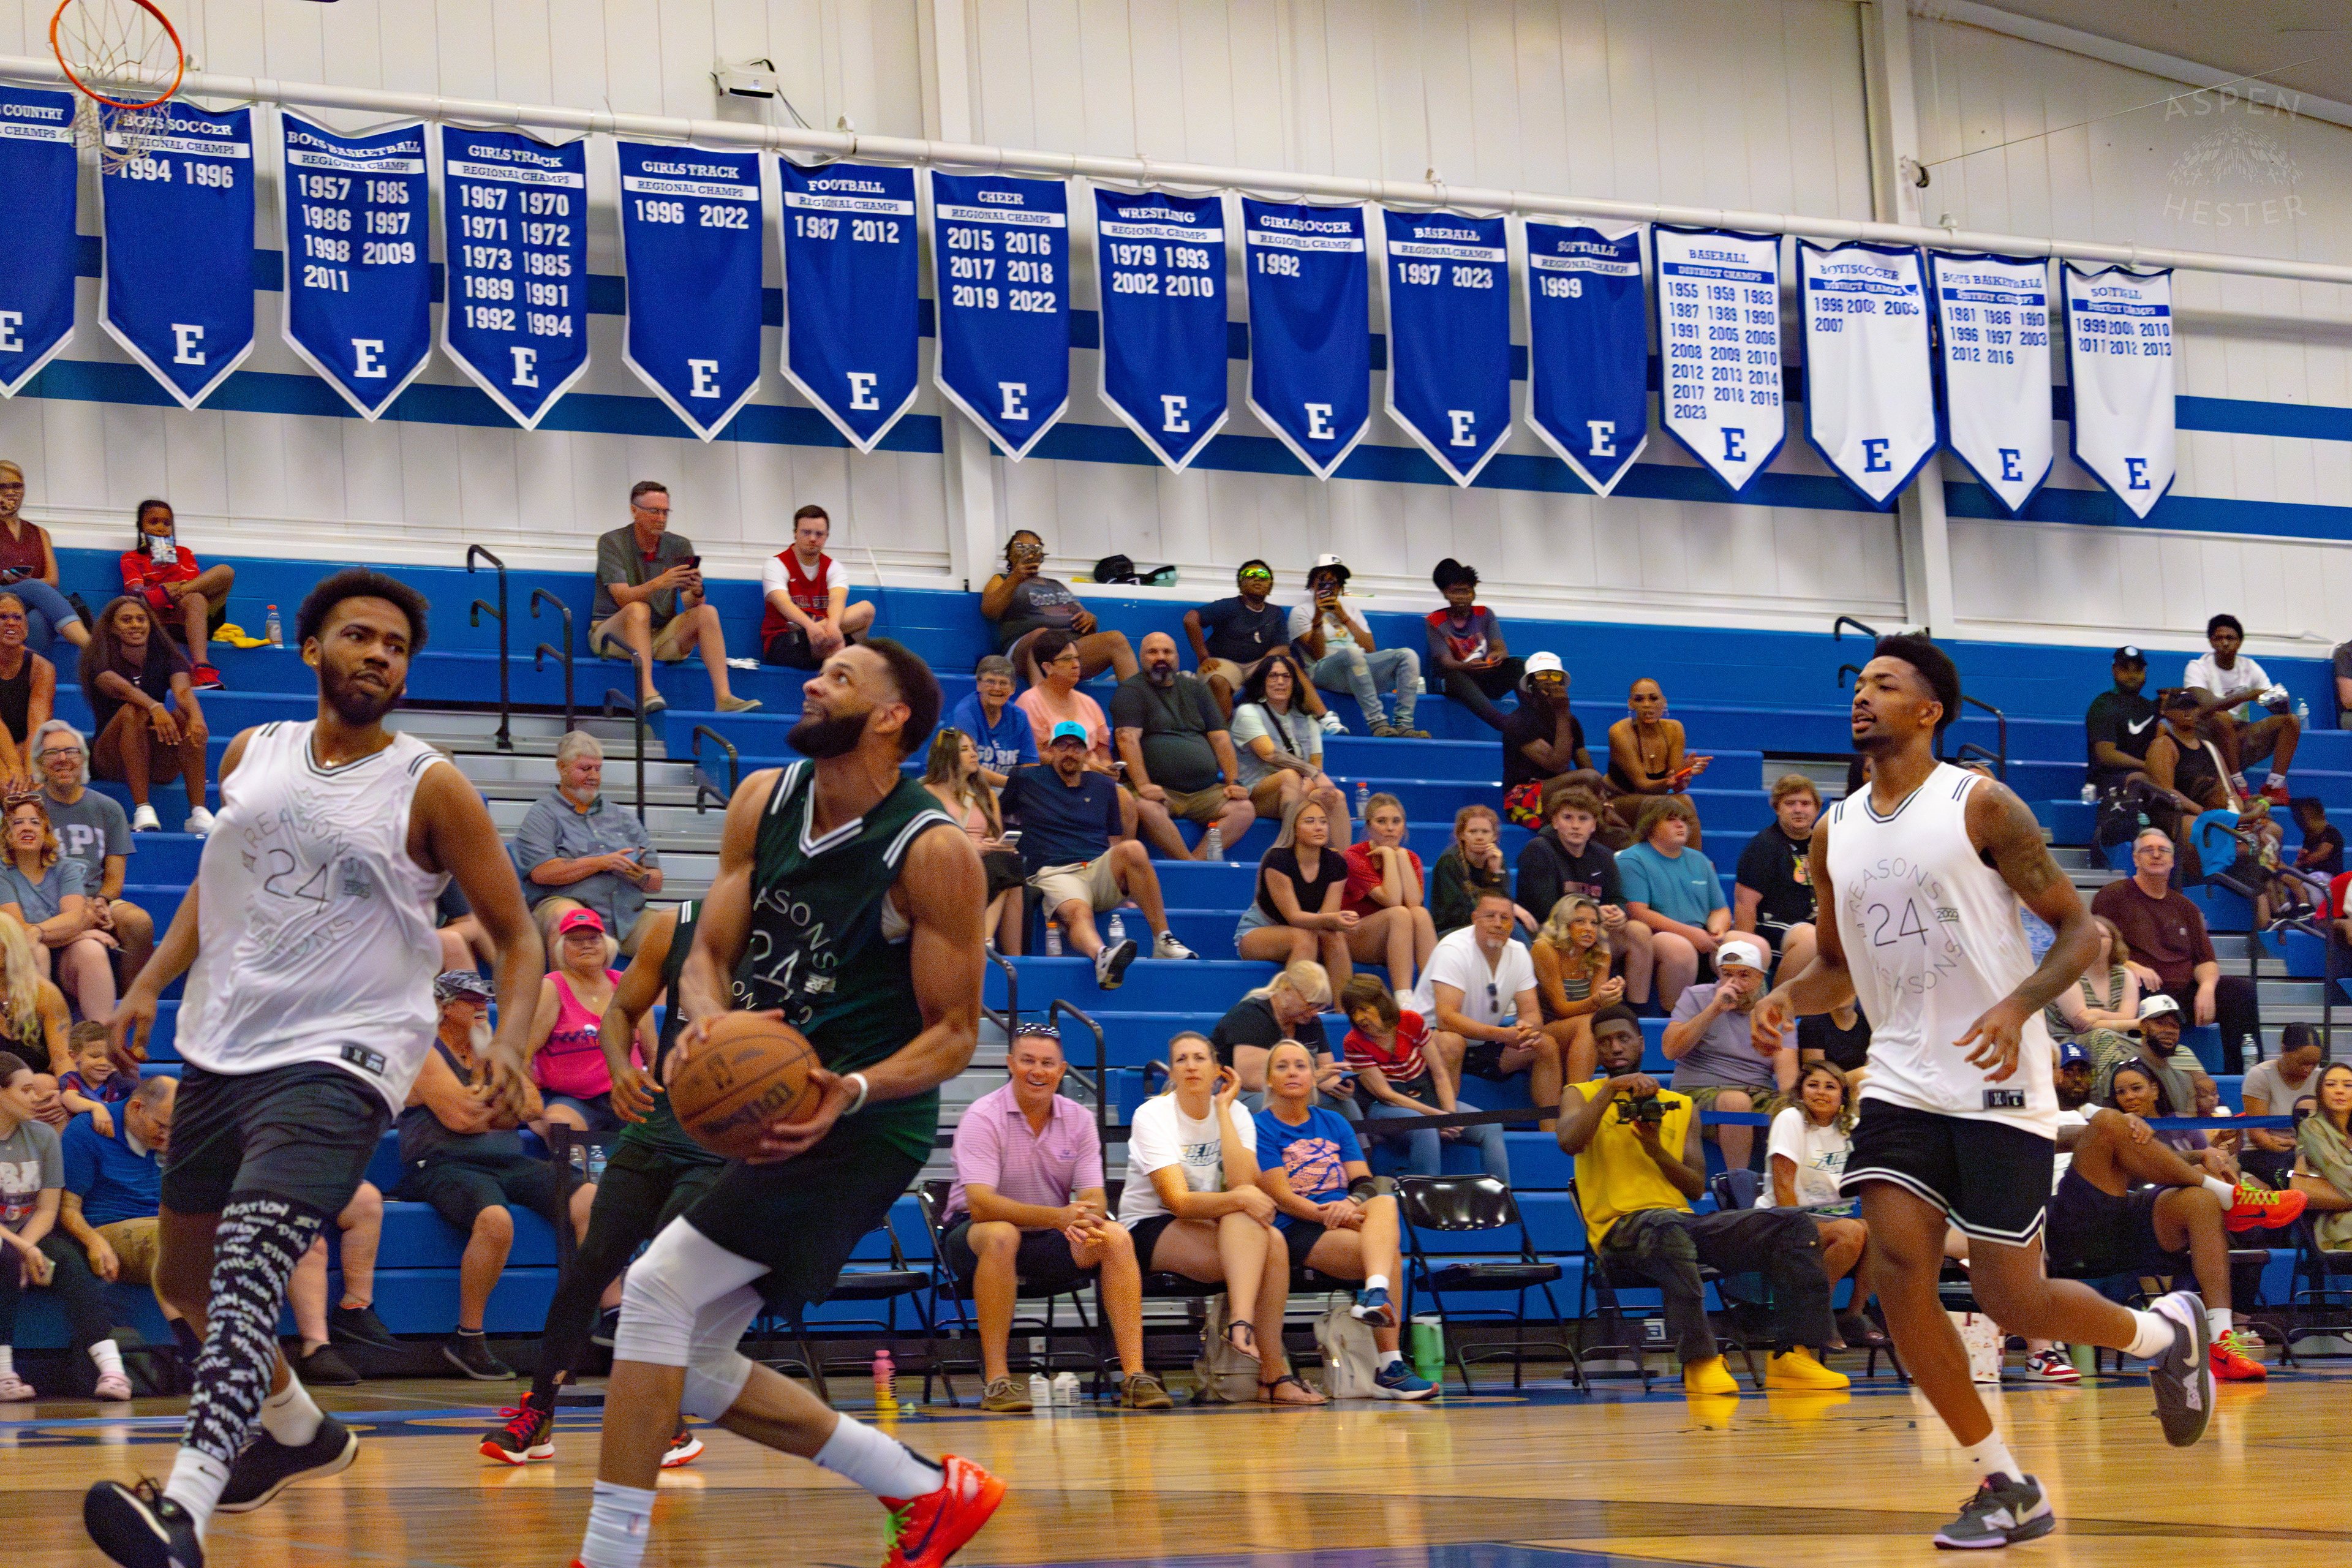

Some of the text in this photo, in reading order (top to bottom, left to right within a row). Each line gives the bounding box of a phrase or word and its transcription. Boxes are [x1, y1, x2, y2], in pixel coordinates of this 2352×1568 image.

[5, 126, 56, 138] CHAMPS
[123, 115, 233, 135] BOYS SOCCER
[187, 142, 234, 154] CHAMPS
[287, 132, 421, 158] BOYS BASKETBALL
[468, 145, 563, 167] GIRLS TRACK
[119, 159, 233, 187] 1994 1996
[302, 155, 365, 170] REGIONAL
[463, 165, 569, 184] REGIONAL CHAMPS
[641, 161, 739, 179] GIRLS TRACK
[298, 174, 409, 204] 1957 1985
[638, 181, 744, 197] REGIONAL CHAMPS
[807, 179, 885, 193] FOOTBALL
[978, 191, 1024, 205] CHEER
[461, 185, 569, 216] 1967 1970
[854, 201, 899, 211] CHAMPS
[302, 205, 410, 234] 1986 1997
[635, 200, 748, 229] 1996 2022
[952, 209, 1050, 224] REGIONAL CHAMPS
[1118, 208, 1196, 222] WRESTLING
[461, 215, 570, 246] 1971 1972
[795, 216, 899, 243] 1987 2012
[948, 227, 1050, 255] 2015 2016
[1413, 227, 1480, 241] BASEBALL
[304, 235, 415, 264] 1998 2009
[463, 245, 571, 276] 1973 1985
[1110, 244, 1210, 270] 1979 1993
[1689, 249, 1749, 263] BASEBALL
[951, 256, 1053, 284] 2017 2018
[1256, 253, 1300, 277] 1992
[1398, 263, 1493, 288] 1997 2023
[304, 265, 349, 292] 2011
[464, 276, 568, 307] 1989 1991
[1113, 271, 1213, 297] 2002 2010
[1540, 276, 1582, 298] 1999
[952, 285, 1057, 312] 2019 2022
[1668, 282, 1773, 305] 1955 1959 1983
[465, 306, 572, 337] 1992 1994
[1670, 302, 1698, 318] 1987
[1744, 309, 1774, 325] 1990
[1815, 317, 1843, 332] 2007
[1948, 307, 1975, 322] 1981
[1671, 323, 1776, 345] 1991 2005 2006
[2077, 318, 2106, 333] 1999
[2139, 323, 2169, 337] 2010
[172, 323, 205, 365] E
[1671, 343, 1702, 359] 2008
[1747, 350, 1777, 366] 2010
[1952, 346, 2013, 364] 2012 2016
[2079, 338, 2171, 356] 2011 2012 2013
[352, 339, 386, 377] E
[511, 347, 538, 388] E
[688, 359, 720, 398] E
[1672, 364, 1703, 380] 2012
[1749, 370, 1778, 385] 2014
[847, 372, 879, 410] E
[998, 382, 1028, 420] E
[1673, 384, 1704, 399] 2017
[1750, 390, 1779, 406] 2019
[1161, 395, 1189, 432] E
[1305, 403, 1334, 439] E
[1674, 404, 1706, 420] 2023
[1448, 410, 1476, 447] E
[1587, 421, 1615, 456] E
[1721, 428, 1746, 462] E
[1862, 439, 1891, 472] E
[1999, 448, 2022, 481] E
[2125, 458, 2150, 489] E
[264, 848, 331, 915] 24
[753, 886, 839, 970] ASONS
[1868, 897, 1929, 946] 24
